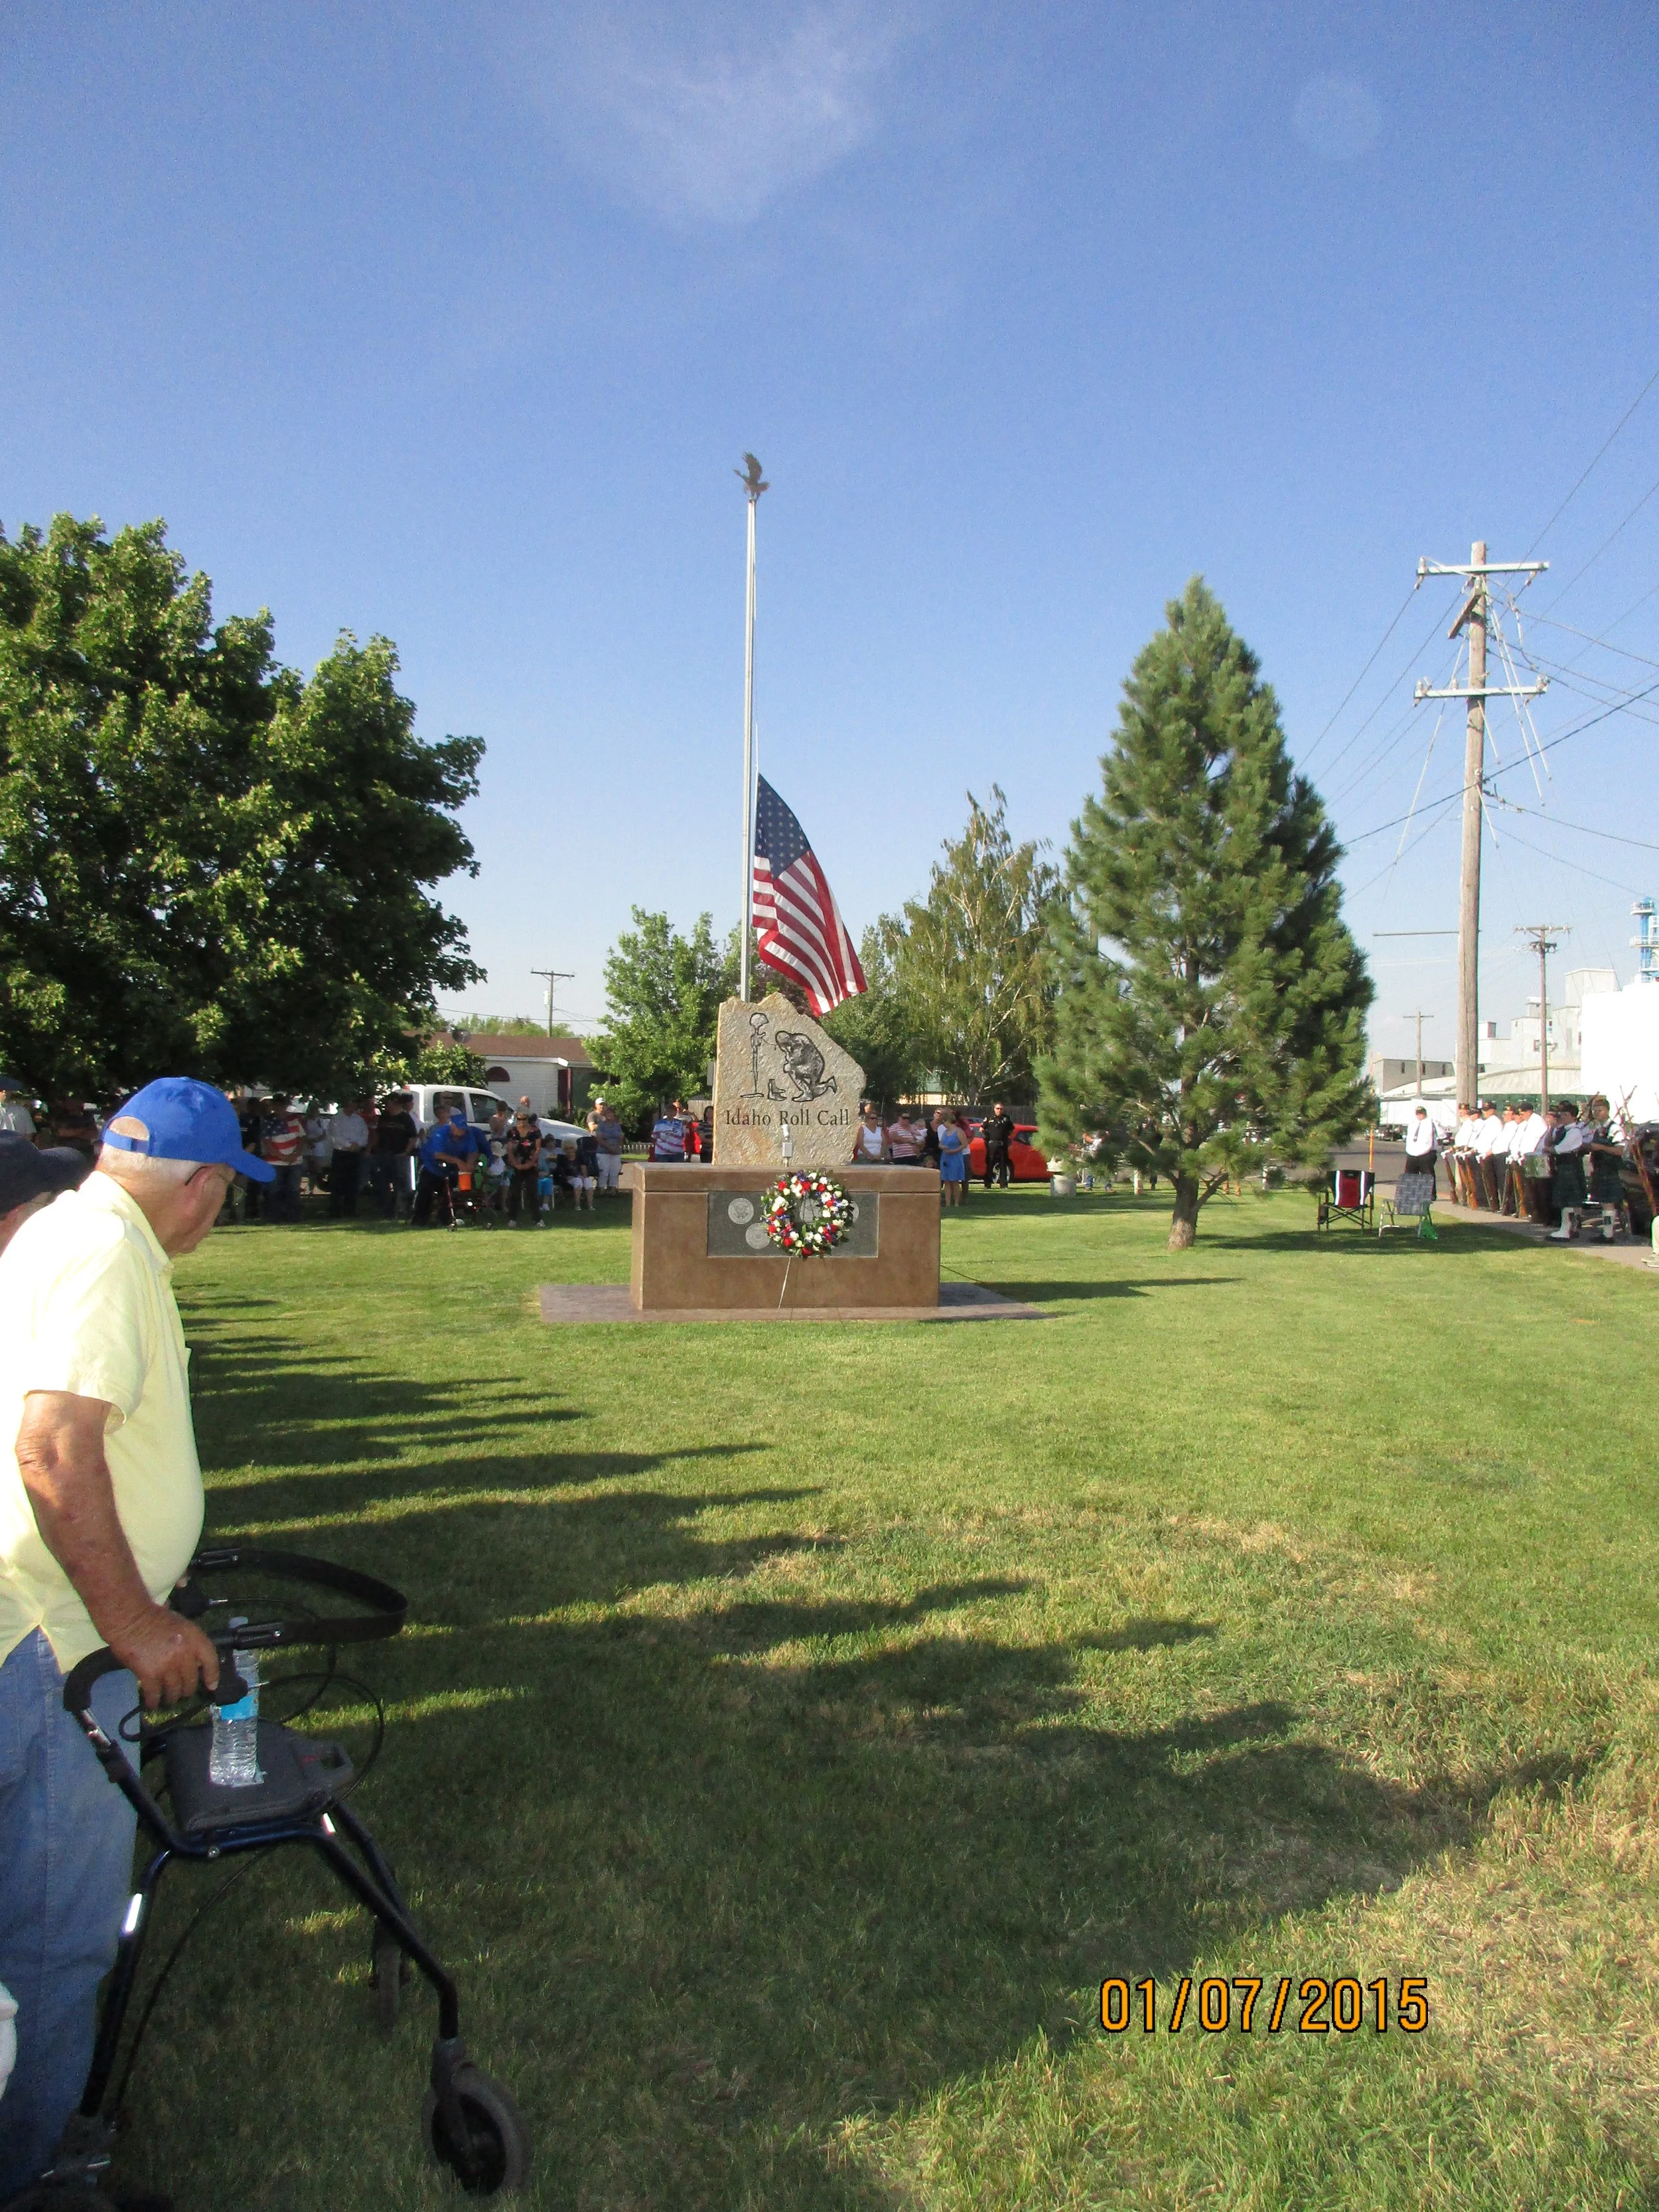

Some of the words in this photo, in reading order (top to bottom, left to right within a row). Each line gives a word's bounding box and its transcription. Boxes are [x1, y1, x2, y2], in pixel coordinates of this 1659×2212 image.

[725, 1108, 771, 1126] Idaho
[779, 1108, 809, 1126] Roll
[817, 1108, 849, 1126] Call
